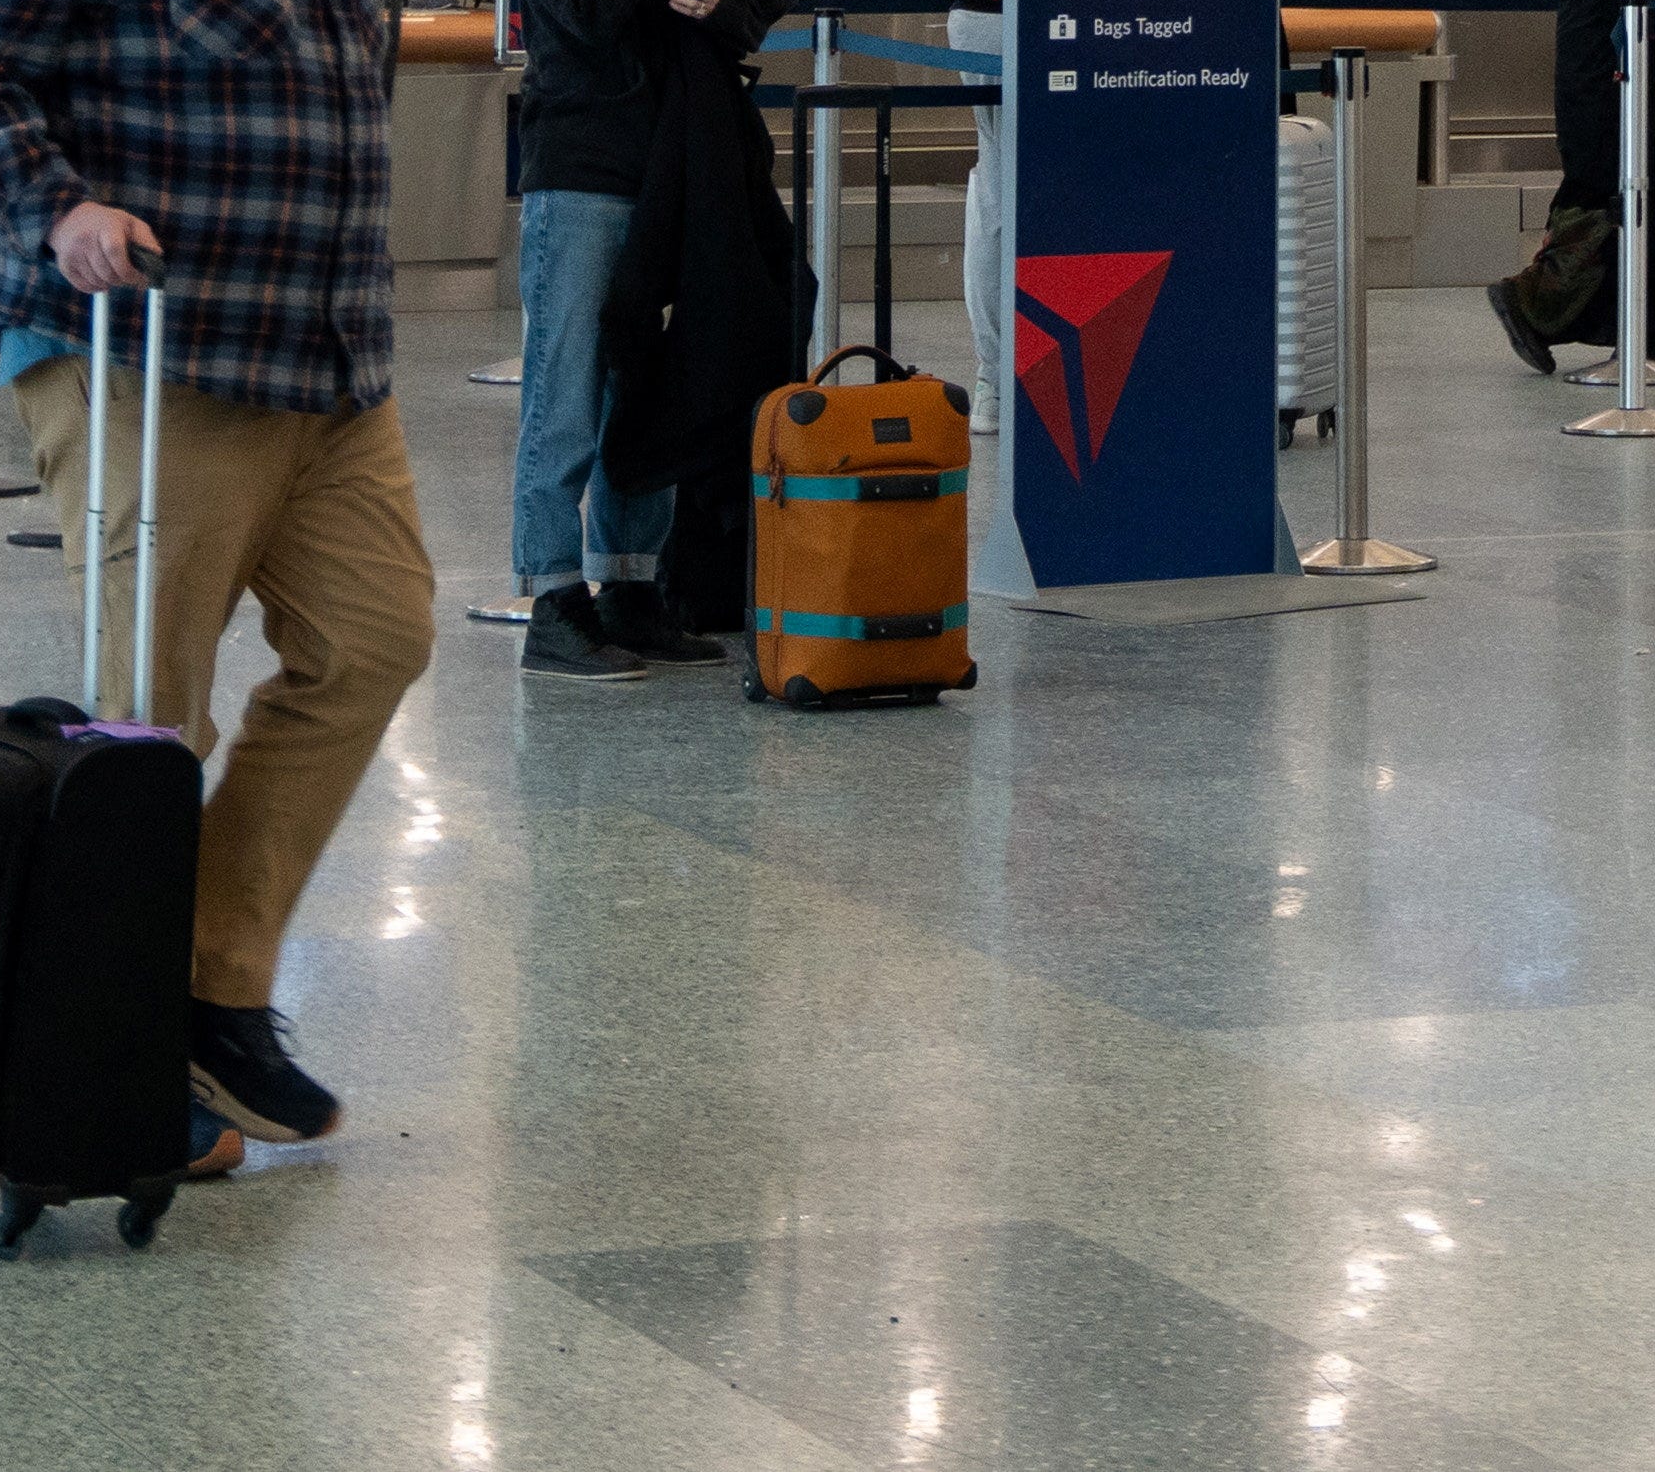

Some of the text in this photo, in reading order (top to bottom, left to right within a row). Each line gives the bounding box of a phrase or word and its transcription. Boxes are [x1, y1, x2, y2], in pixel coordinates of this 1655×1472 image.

[1094, 16, 1192, 38] Bags Tagged
[1094, 68, 1249, 91] Identification Ready
